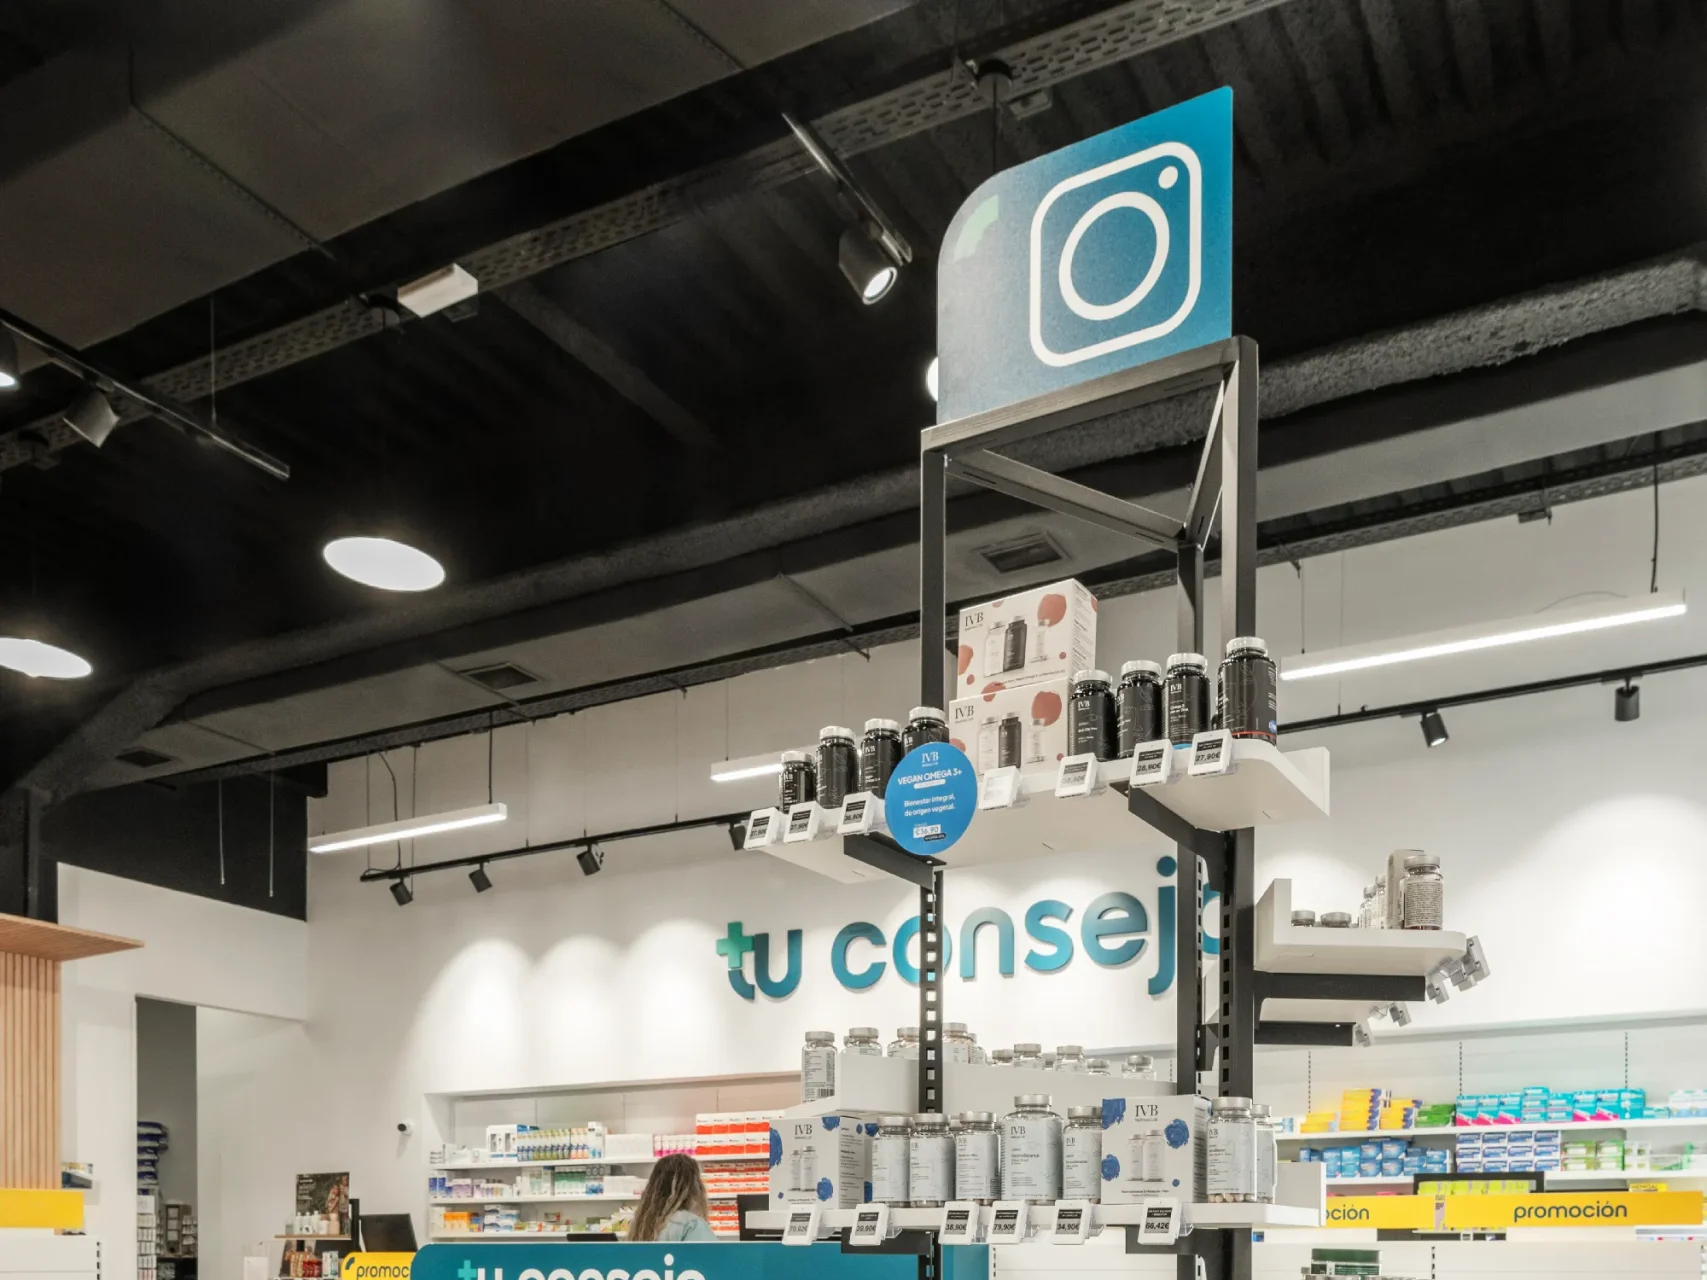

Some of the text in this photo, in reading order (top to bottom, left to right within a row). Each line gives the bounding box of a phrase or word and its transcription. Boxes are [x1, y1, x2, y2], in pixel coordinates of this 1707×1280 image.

[965, 612, 984, 627] IVB
[955, 705, 974, 719] IVB
[922, 751, 939, 763] IVB
[1196, 750, 1221, 761] 27,90€
[1137, 761, 1161, 772] 28,90€
[897, 767, 962, 785] VEGAN OMEGA 3+
[904, 796, 931, 807] Bienestar
[904, 809, 912, 817] de
[716, 921, 803, 1001] tu
[1135, 1104, 1158, 1116] IVB
[794, 1125, 812, 1136] IVB
[1011, 1126, 1025, 1136] IVB
[1326, 1203, 1370, 1220] ción
[1514, 1201, 1627, 1222] promoción
[945, 1222, 967, 1231] 38,90€
[993, 1222, 1016, 1231] 79,90€
[1056, 1222, 1079, 1231] 34,90€
[1145, 1221, 1169, 1231] 66,42€
